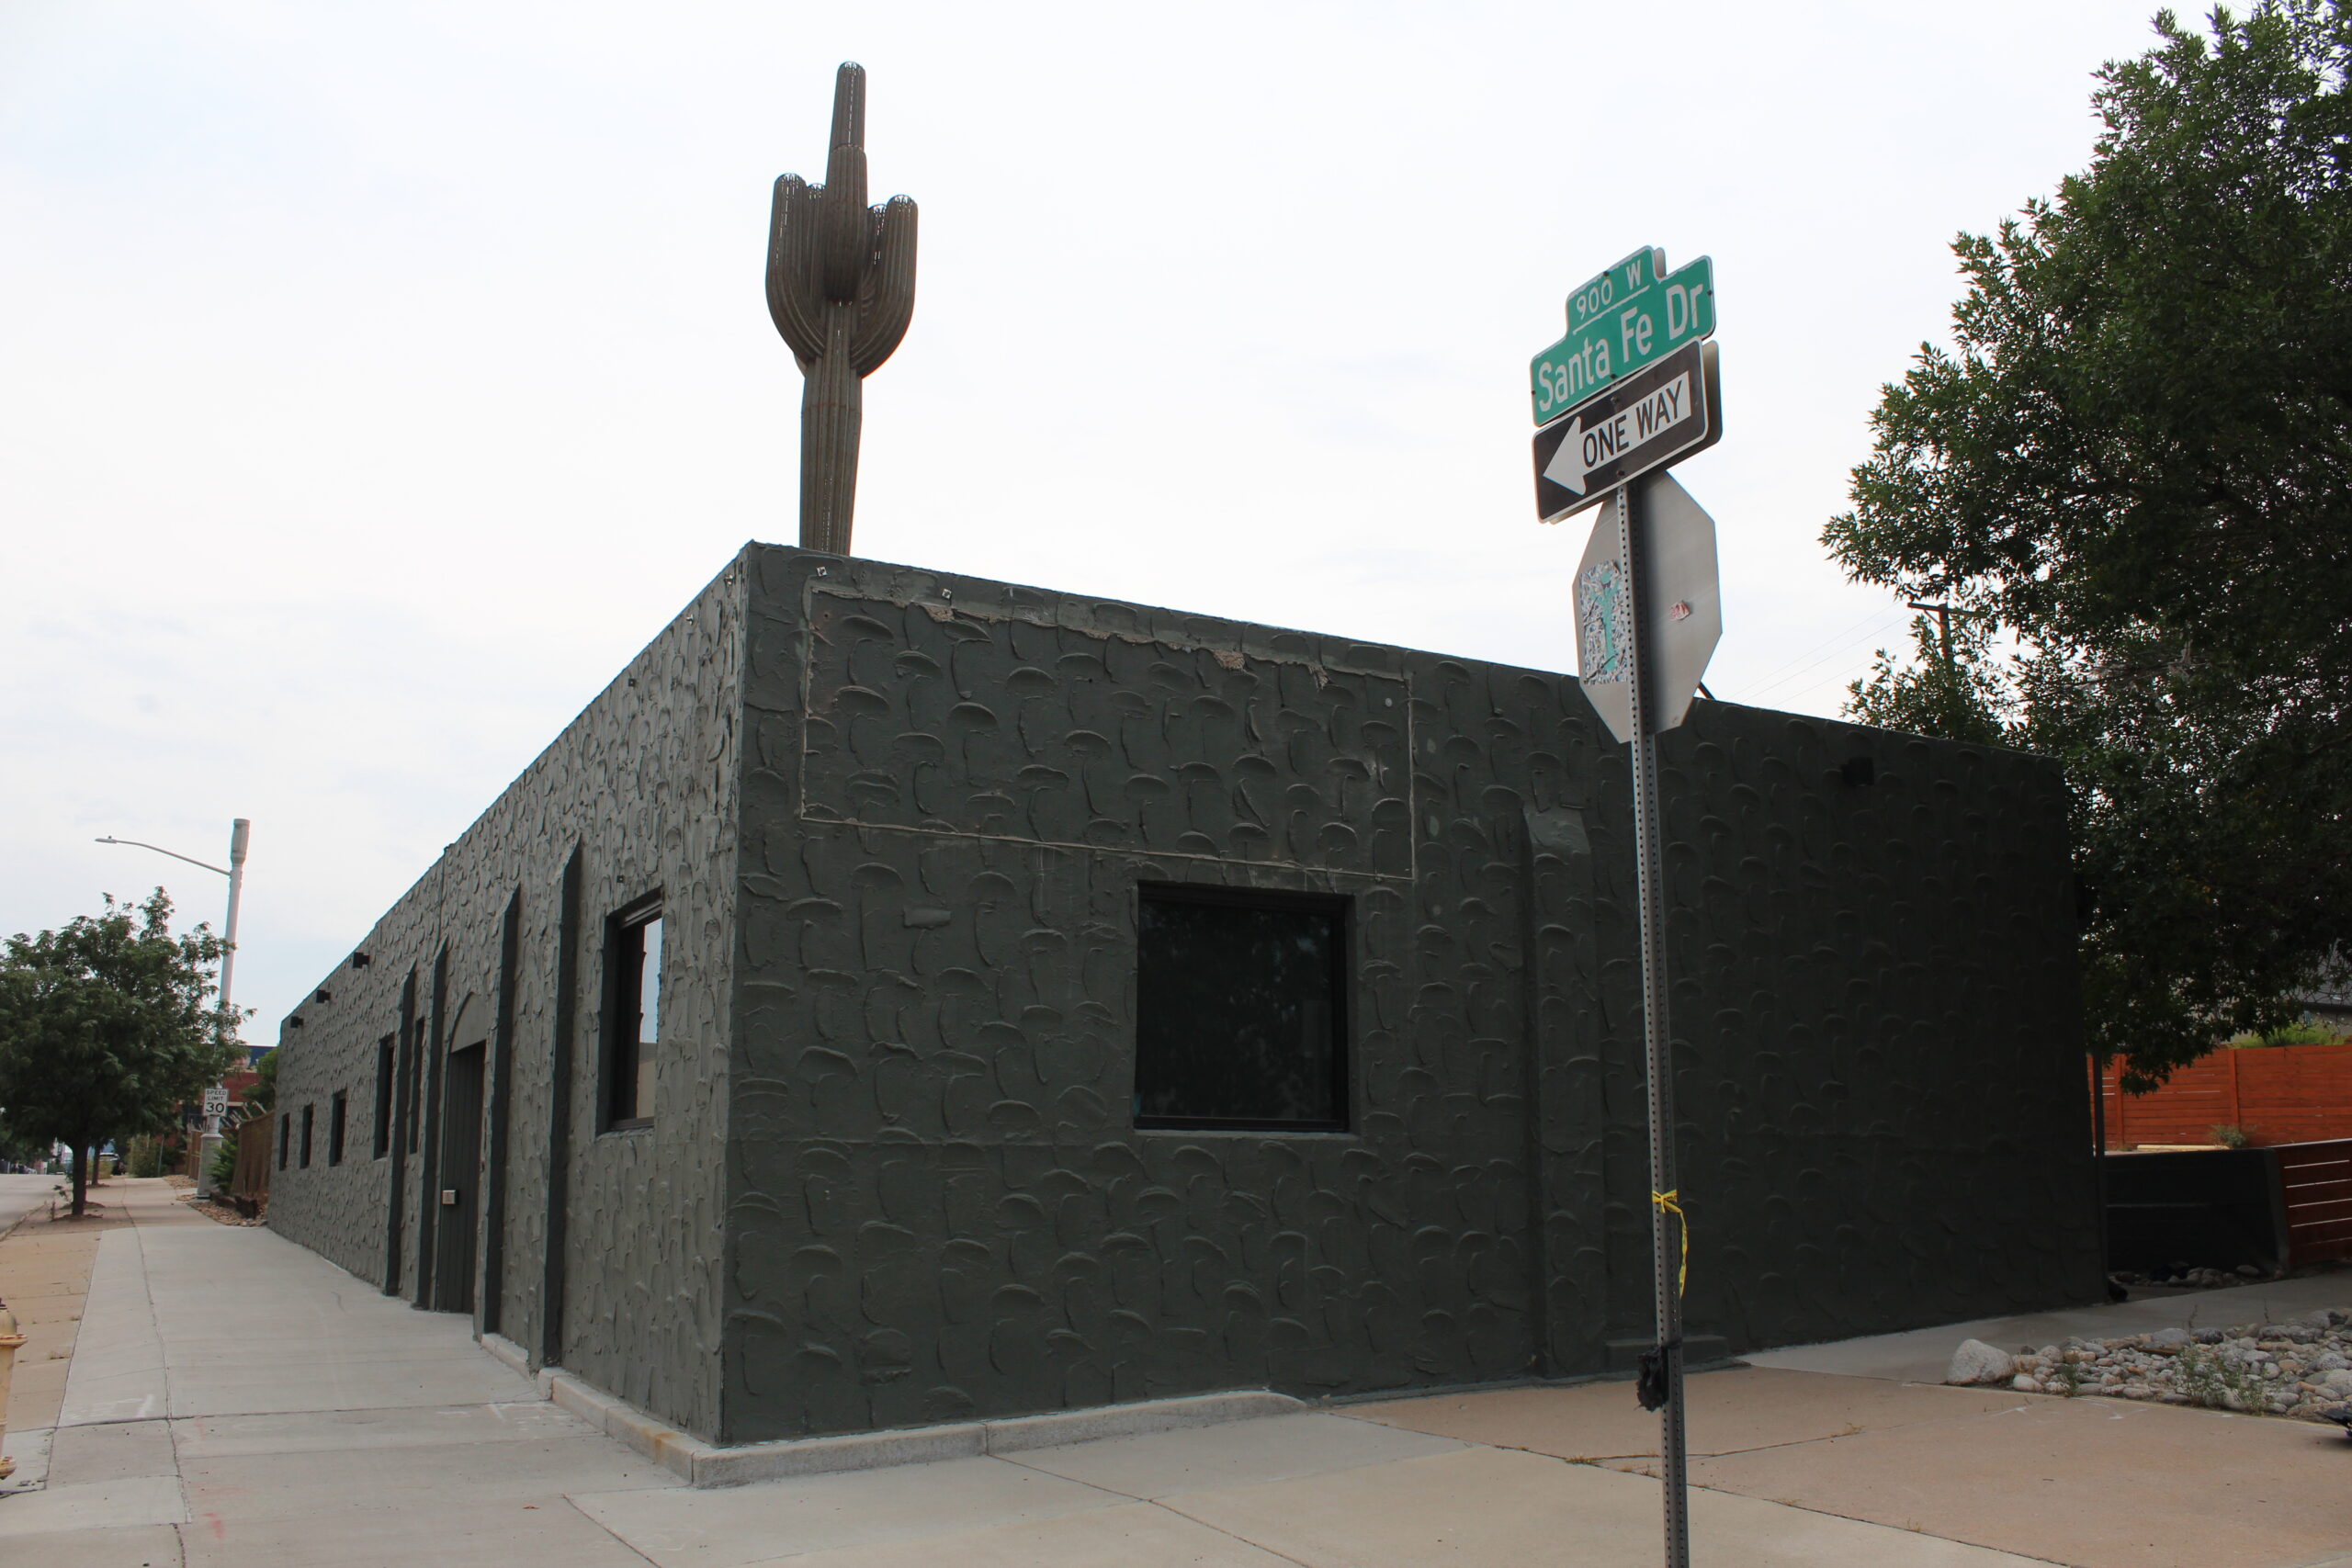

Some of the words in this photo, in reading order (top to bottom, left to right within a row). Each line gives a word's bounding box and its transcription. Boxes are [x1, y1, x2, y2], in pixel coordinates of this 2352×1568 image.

[1577, 278, 1612, 320] 900
[1625, 259, 1642, 290] W
[1538, 336, 1611, 412] Santa
[1620, 306, 1653, 363] Fe
[1665, 283, 1703, 340] Dr
[1583, 413, 1629, 468] ONE
[1635, 379, 1682, 440] WAY
[205, 1102, 224, 1112] 30
